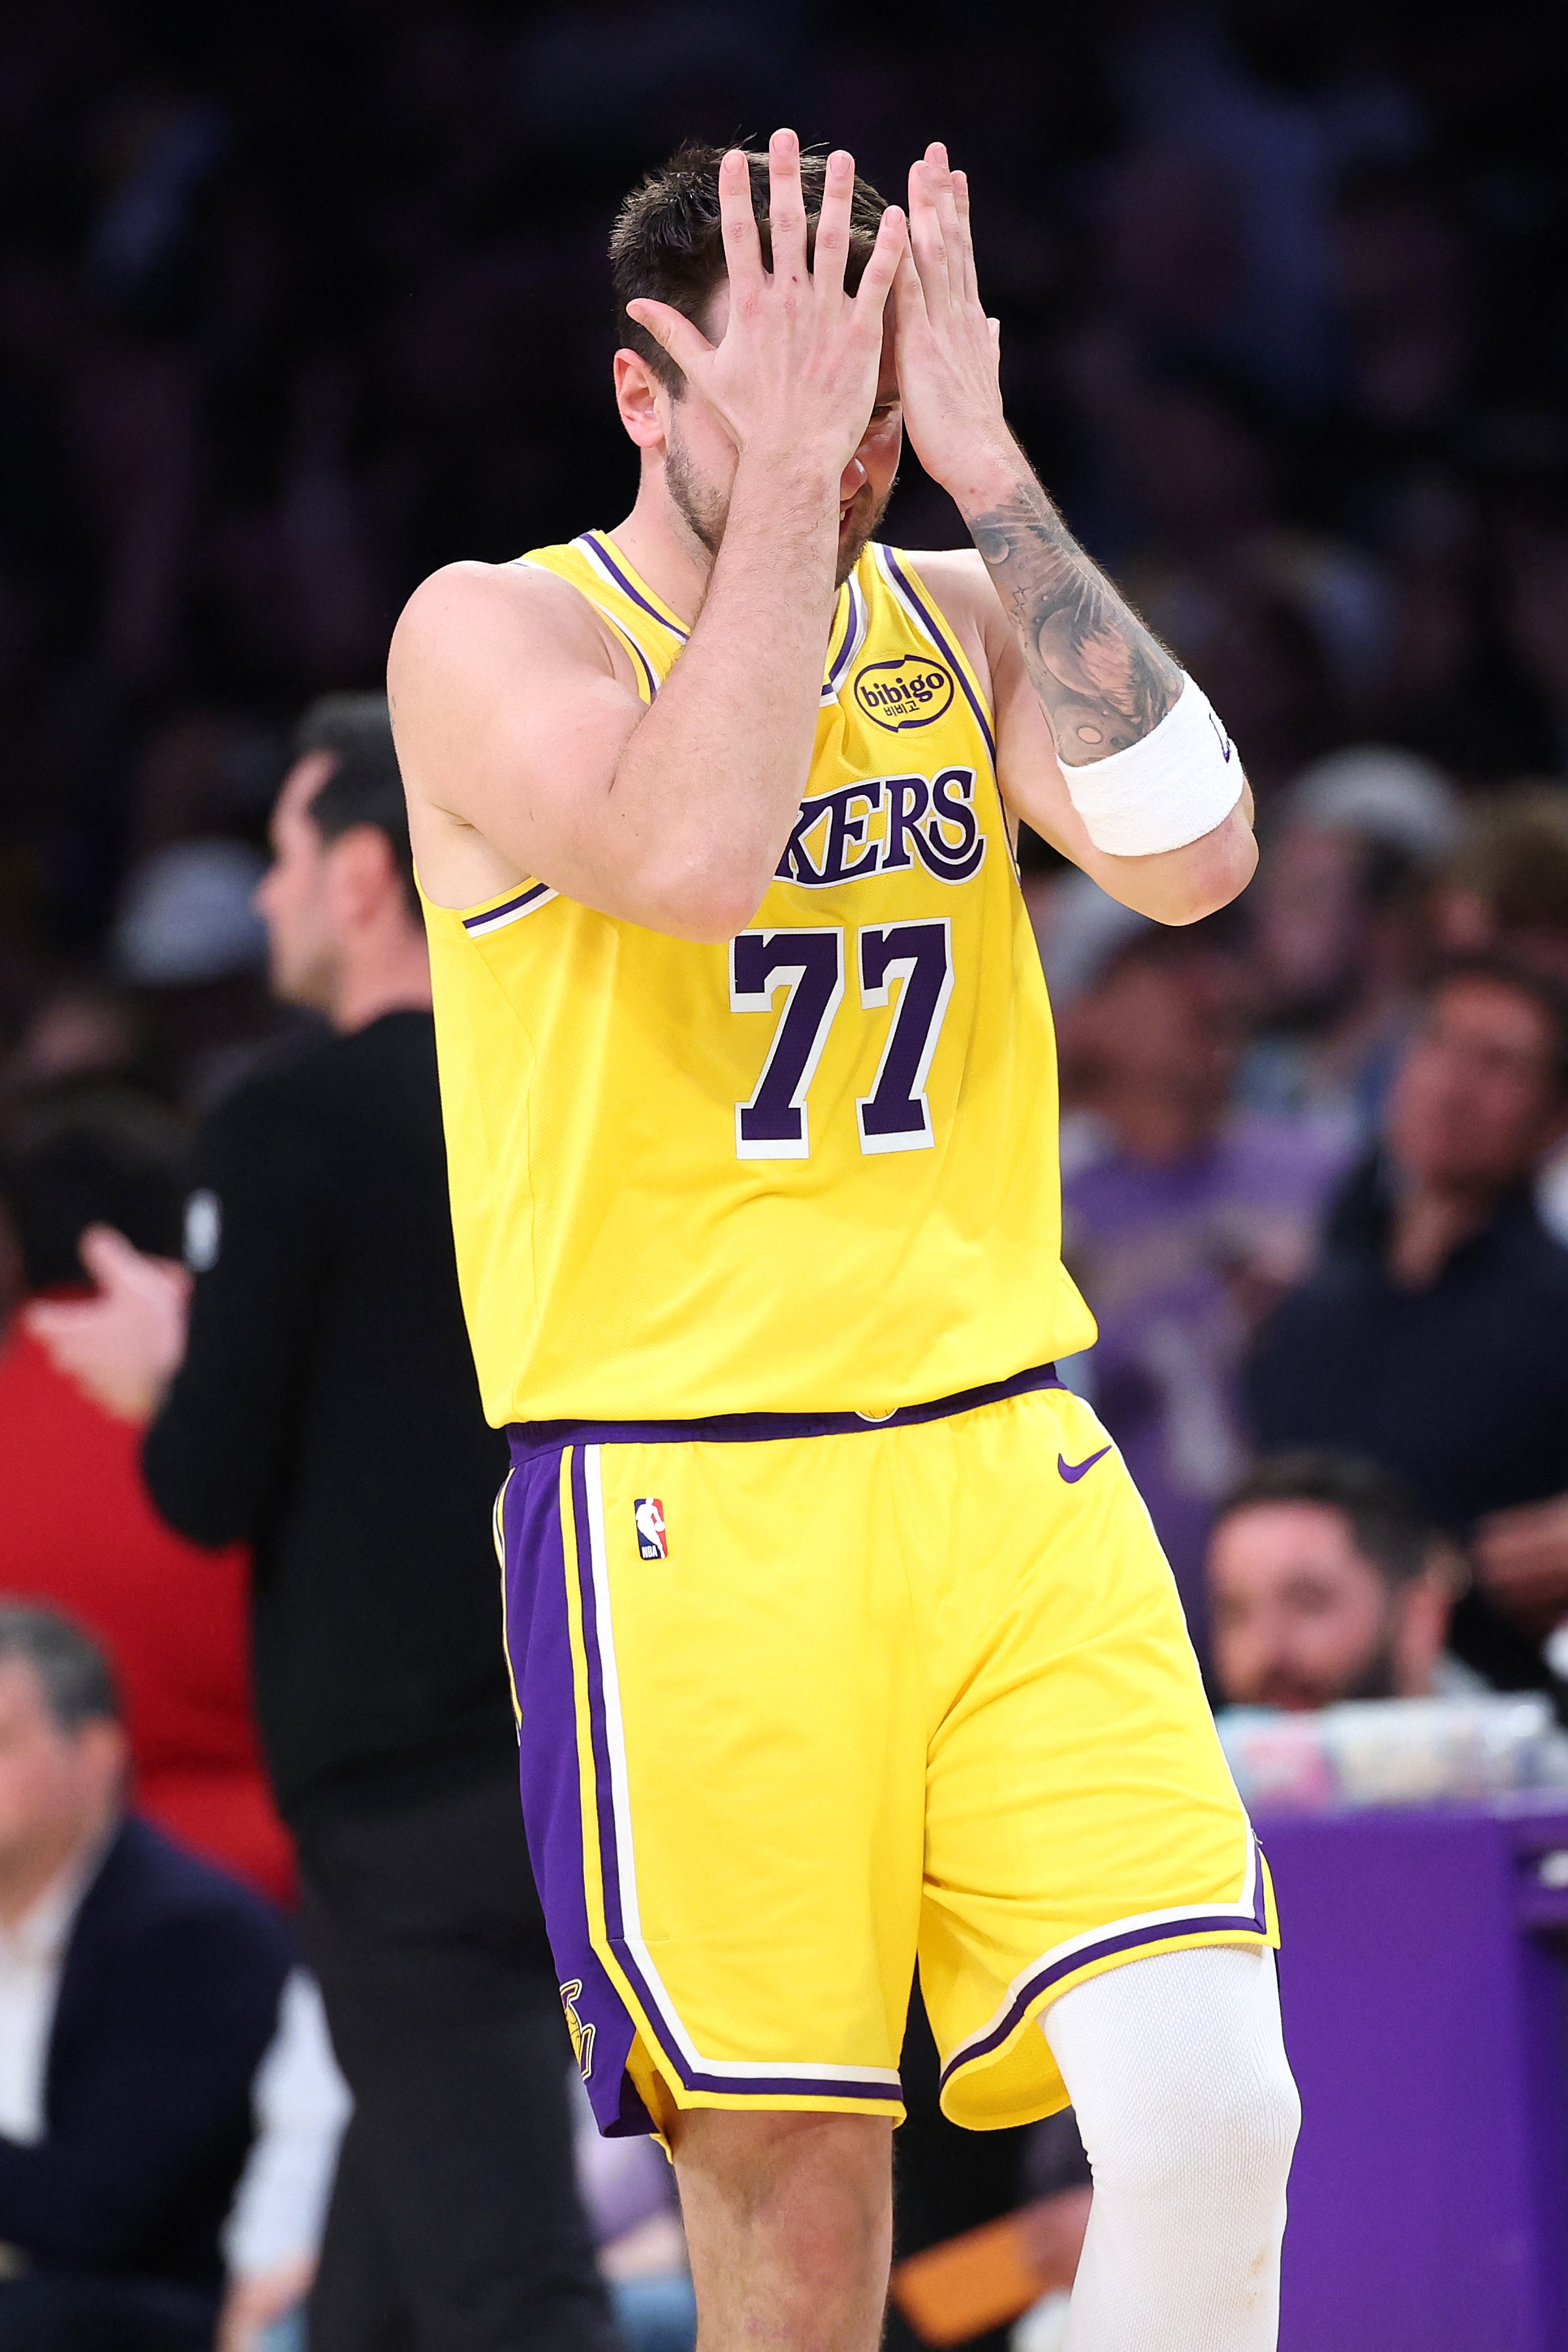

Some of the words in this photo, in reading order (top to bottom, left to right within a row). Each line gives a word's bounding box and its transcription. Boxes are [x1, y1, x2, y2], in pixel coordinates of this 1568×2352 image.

[860, 672, 945, 707] bibigo
[883, 700, 920, 717] 비비고
[772, 765, 987, 889] KERS
[729, 917, 955, 1160] 77
[641, 1544, 658, 1559] NBA
